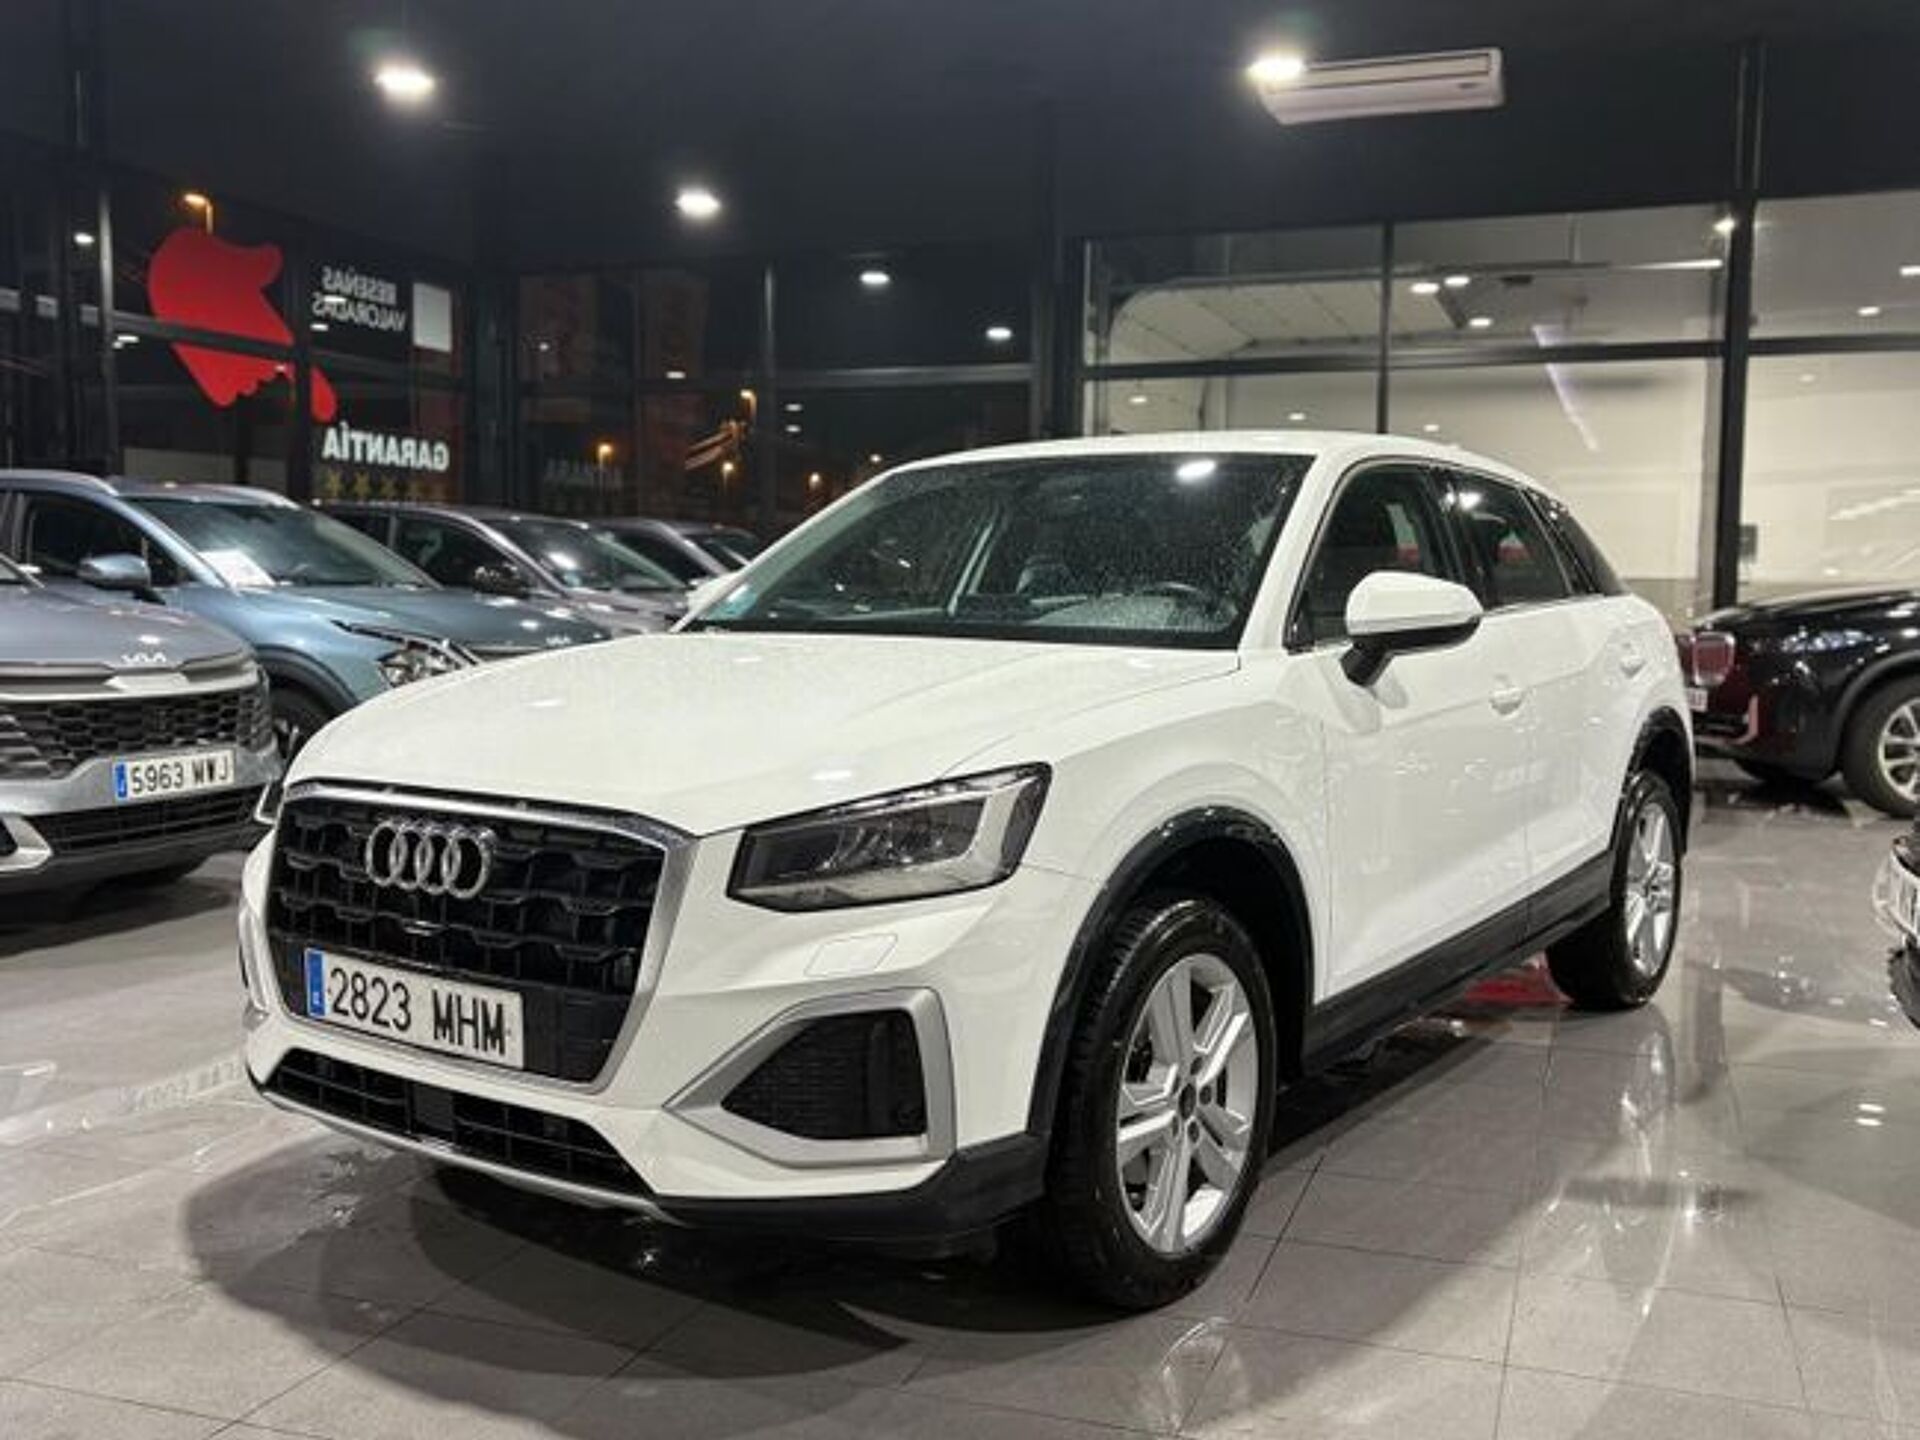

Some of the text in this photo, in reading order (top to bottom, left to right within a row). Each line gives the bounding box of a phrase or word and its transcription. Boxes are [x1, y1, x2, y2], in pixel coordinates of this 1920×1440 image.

[131, 763, 184, 794] 5963
[330, 967, 506, 1056] 2823 MHM
